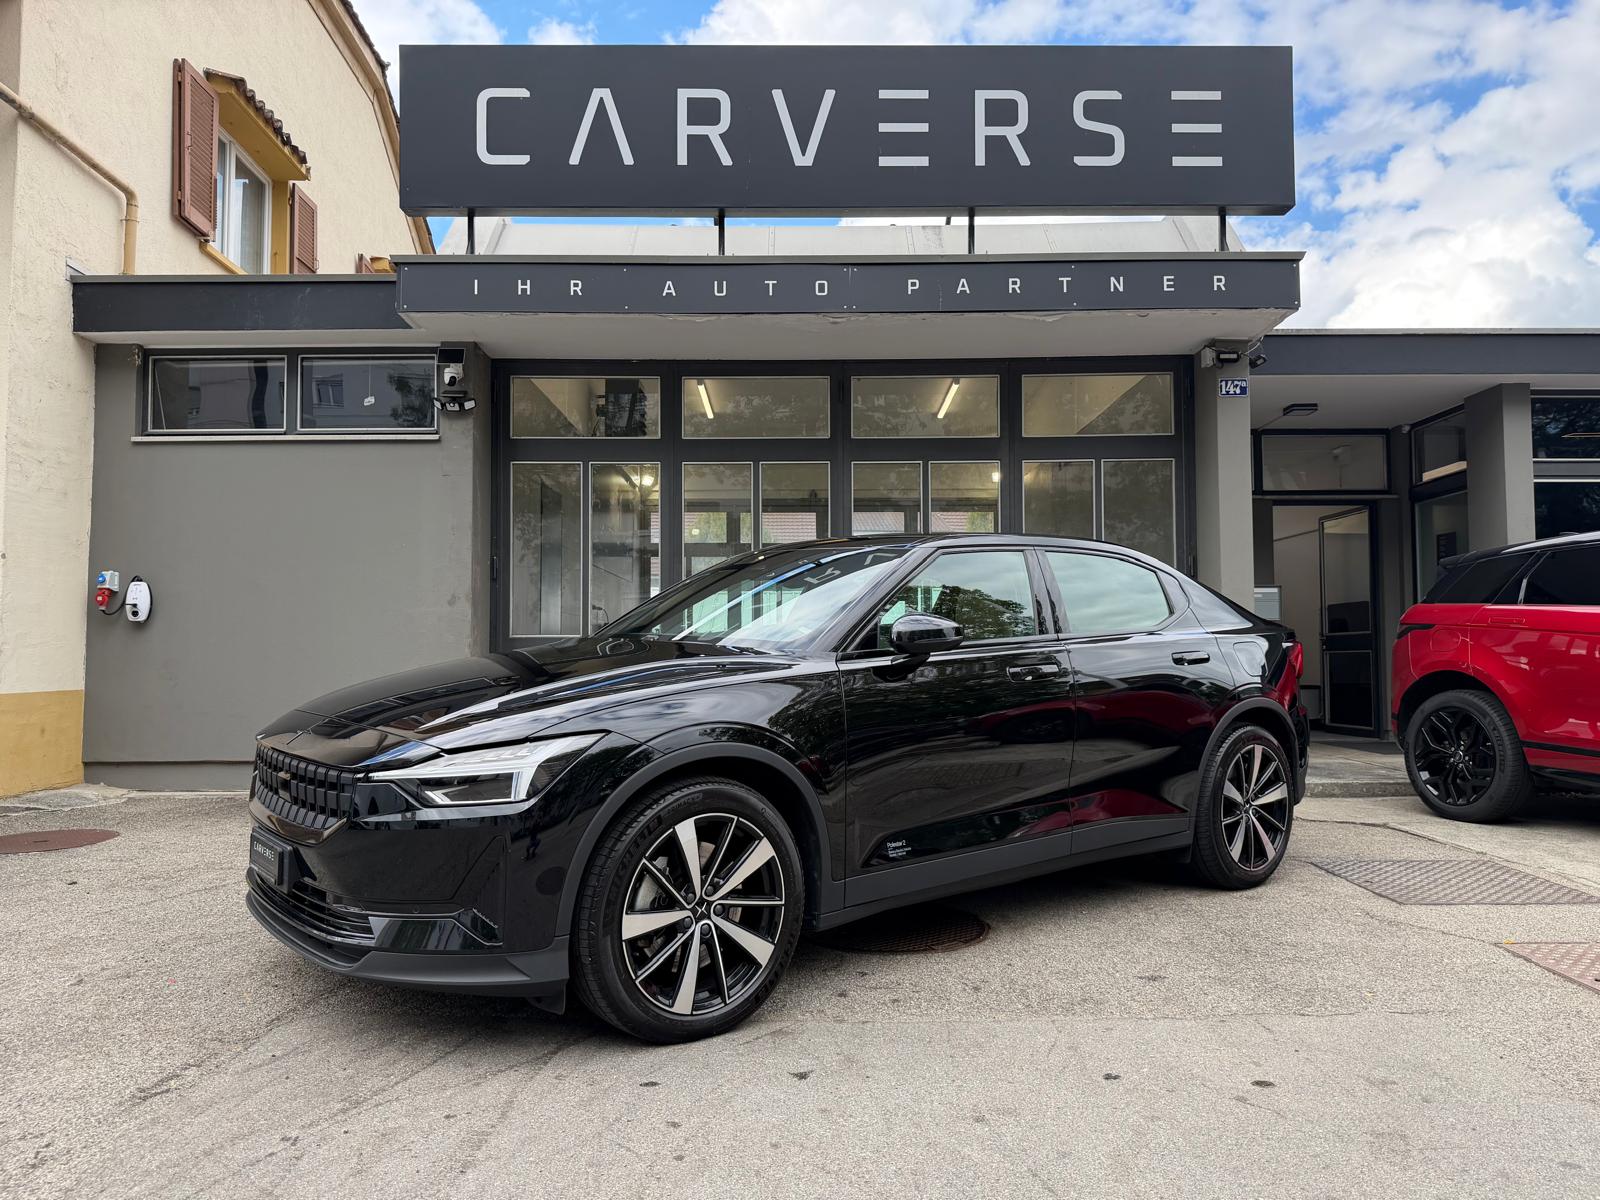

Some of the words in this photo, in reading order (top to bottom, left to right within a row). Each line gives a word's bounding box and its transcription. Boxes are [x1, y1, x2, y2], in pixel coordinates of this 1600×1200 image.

[476, 87, 1223, 167] CARVERSE
[474, 279, 583, 296] IHR
[662, 280, 829, 297] AUTO
[907, 275, 1226, 295] PARTNER
